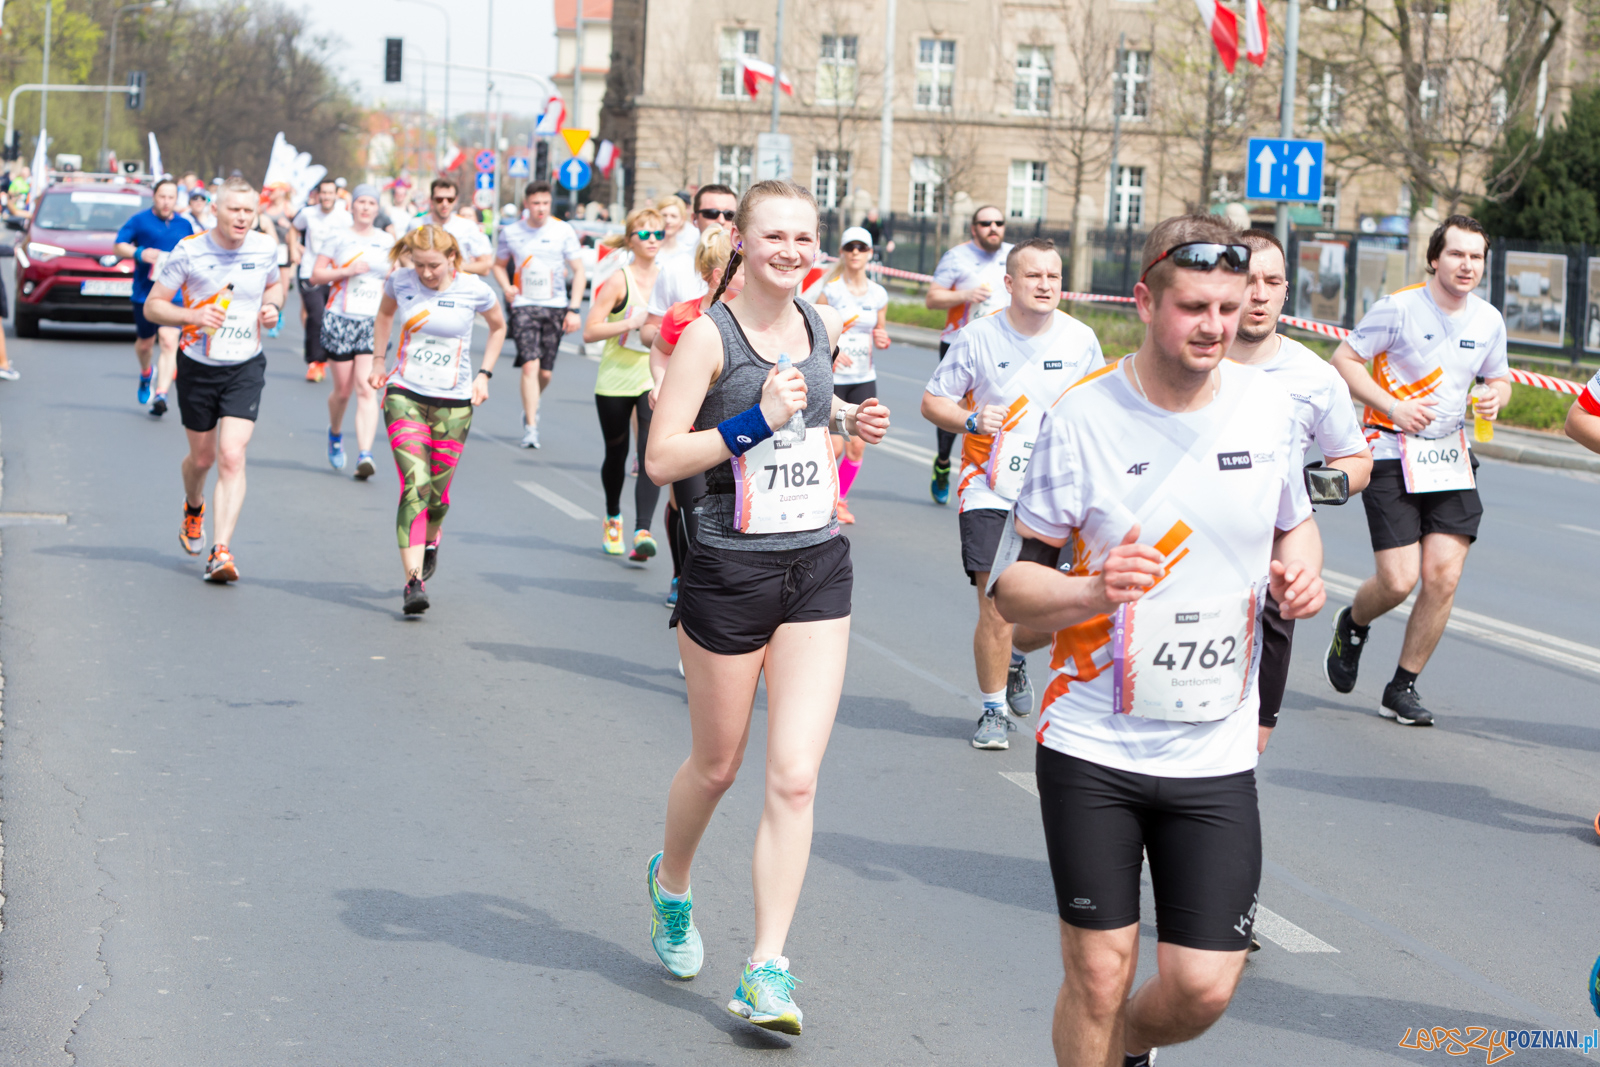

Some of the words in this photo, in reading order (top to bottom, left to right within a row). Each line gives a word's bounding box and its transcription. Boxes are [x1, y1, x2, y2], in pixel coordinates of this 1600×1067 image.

[220, 326, 251, 339] 7766
[413, 348, 451, 367] 4929
[1221, 455, 1250, 466] 11.PKO
[1417, 448, 1459, 465] 4049
[1126, 462, 1150, 475] 4F
[764, 461, 819, 490] 7182
[779, 492, 809, 503] Zuzanna
[1153, 635, 1236, 671] 4762
[1171, 677, 1222, 687] Bartłomiej
